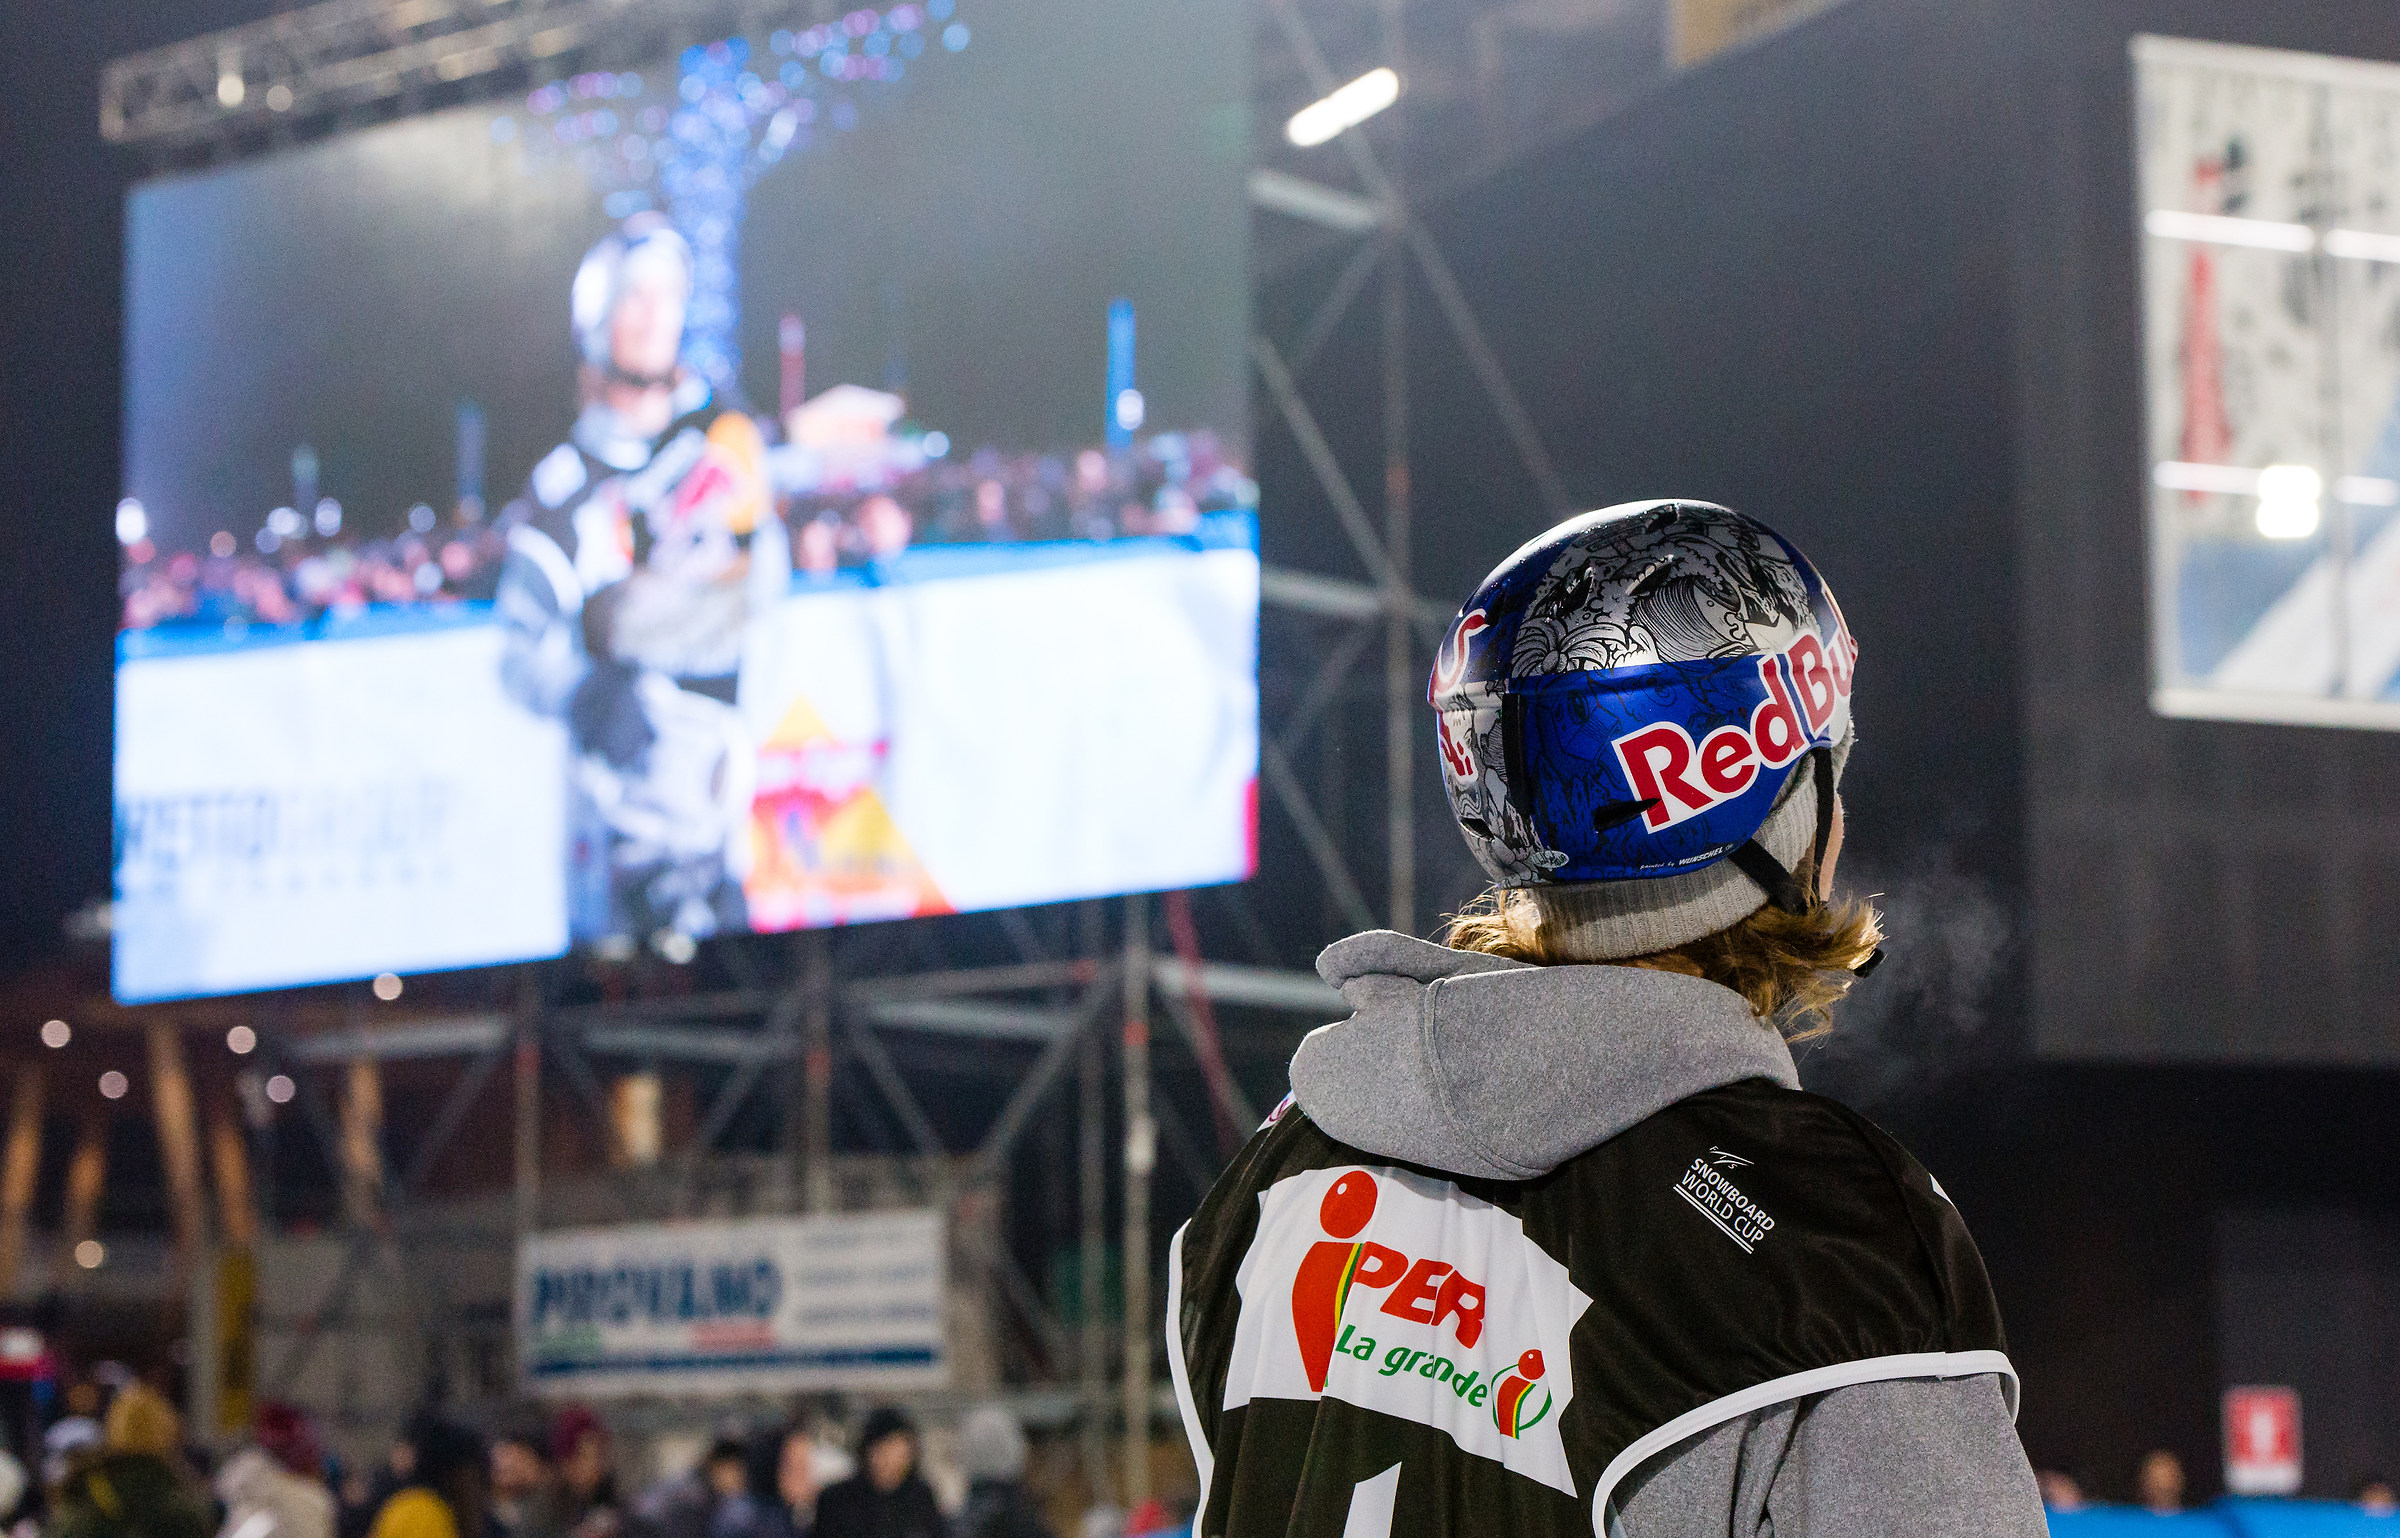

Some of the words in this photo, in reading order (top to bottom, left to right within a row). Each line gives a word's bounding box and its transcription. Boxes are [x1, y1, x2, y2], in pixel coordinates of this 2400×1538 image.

[1617, 656, 1808, 830] Red
[1681, 1169, 1734, 1220] WORLD
[1734, 1215, 1765, 1243] CUP
[1690, 1158, 1775, 1231] SNOWBOARD
[1335, 1324, 1376, 1361] La
[1378, 1346, 1488, 1408] grande
